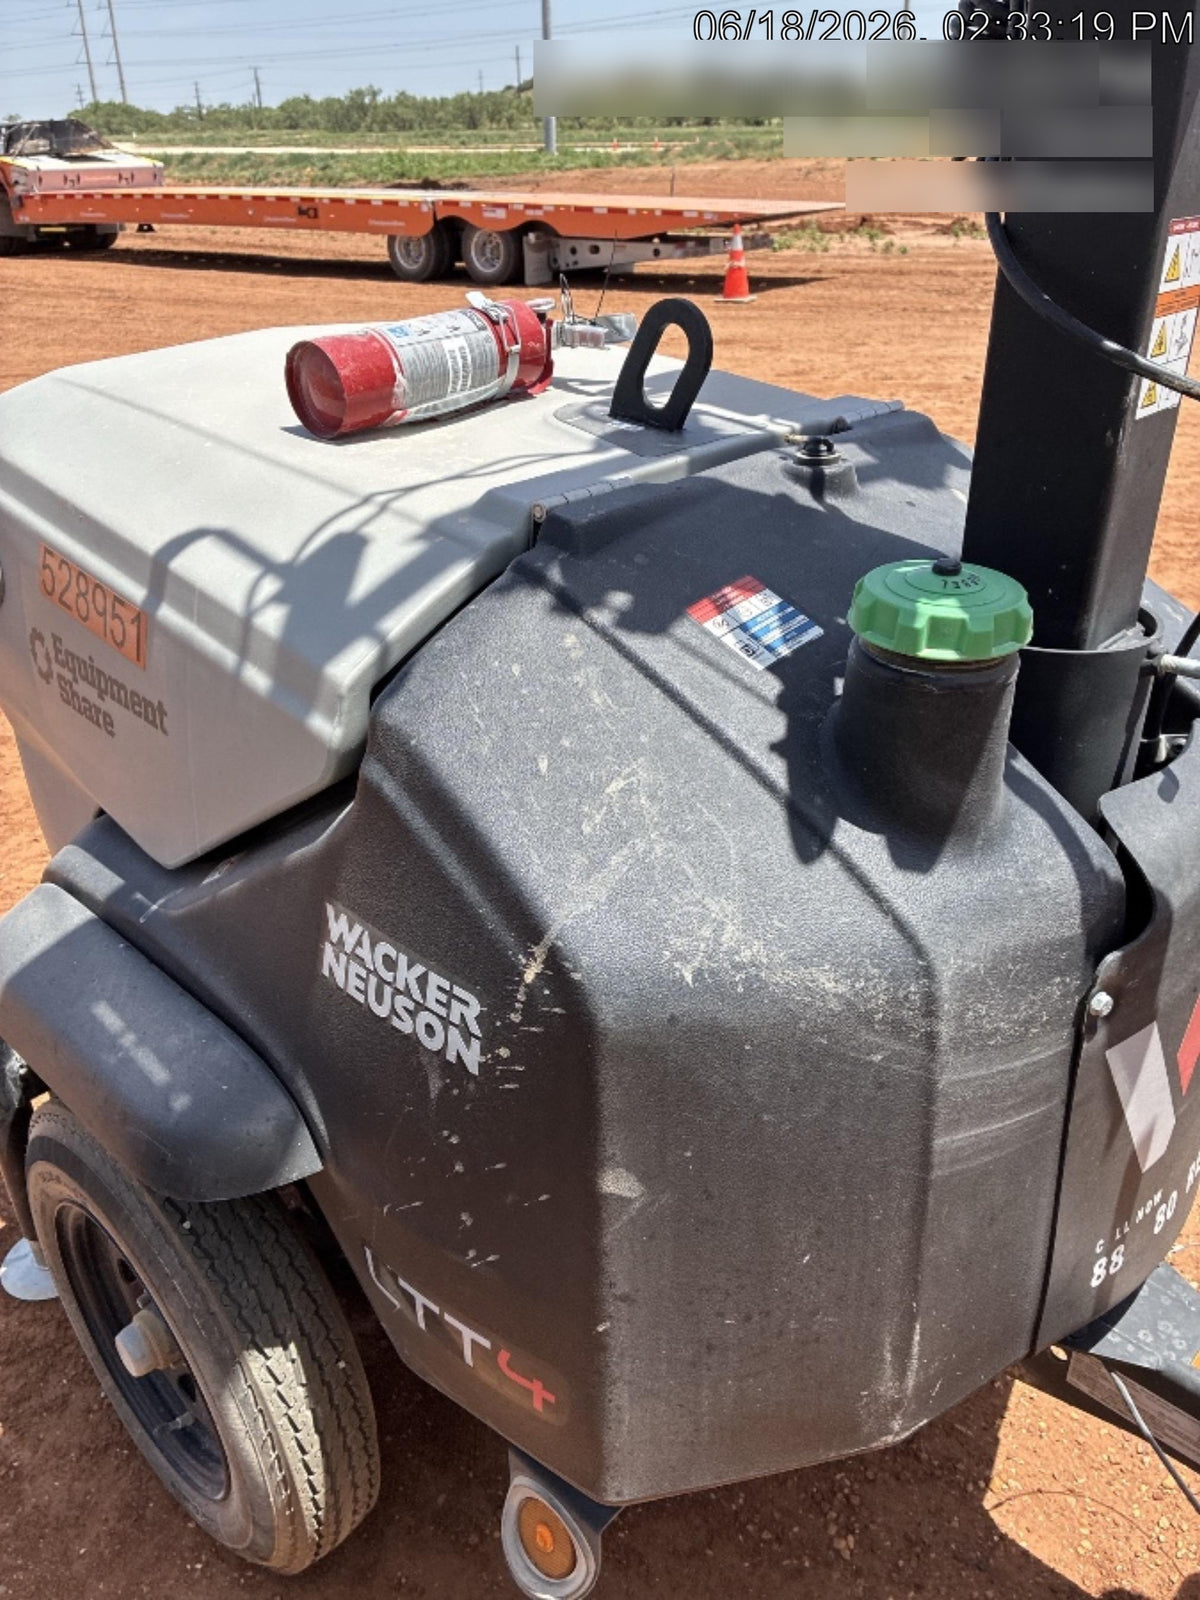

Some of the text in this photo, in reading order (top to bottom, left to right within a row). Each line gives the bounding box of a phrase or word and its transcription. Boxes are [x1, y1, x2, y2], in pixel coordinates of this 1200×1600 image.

[40, 545, 143, 663] 528951
[50, 632, 170, 737] Equipment
[56, 673, 116, 739] Share
[321, 941, 482, 1076] NEUSON
[325, 902, 482, 1038] WACKER
[1135, 1188, 1164, 1224] NOW
[363, 1246, 556, 1413] LTT4
